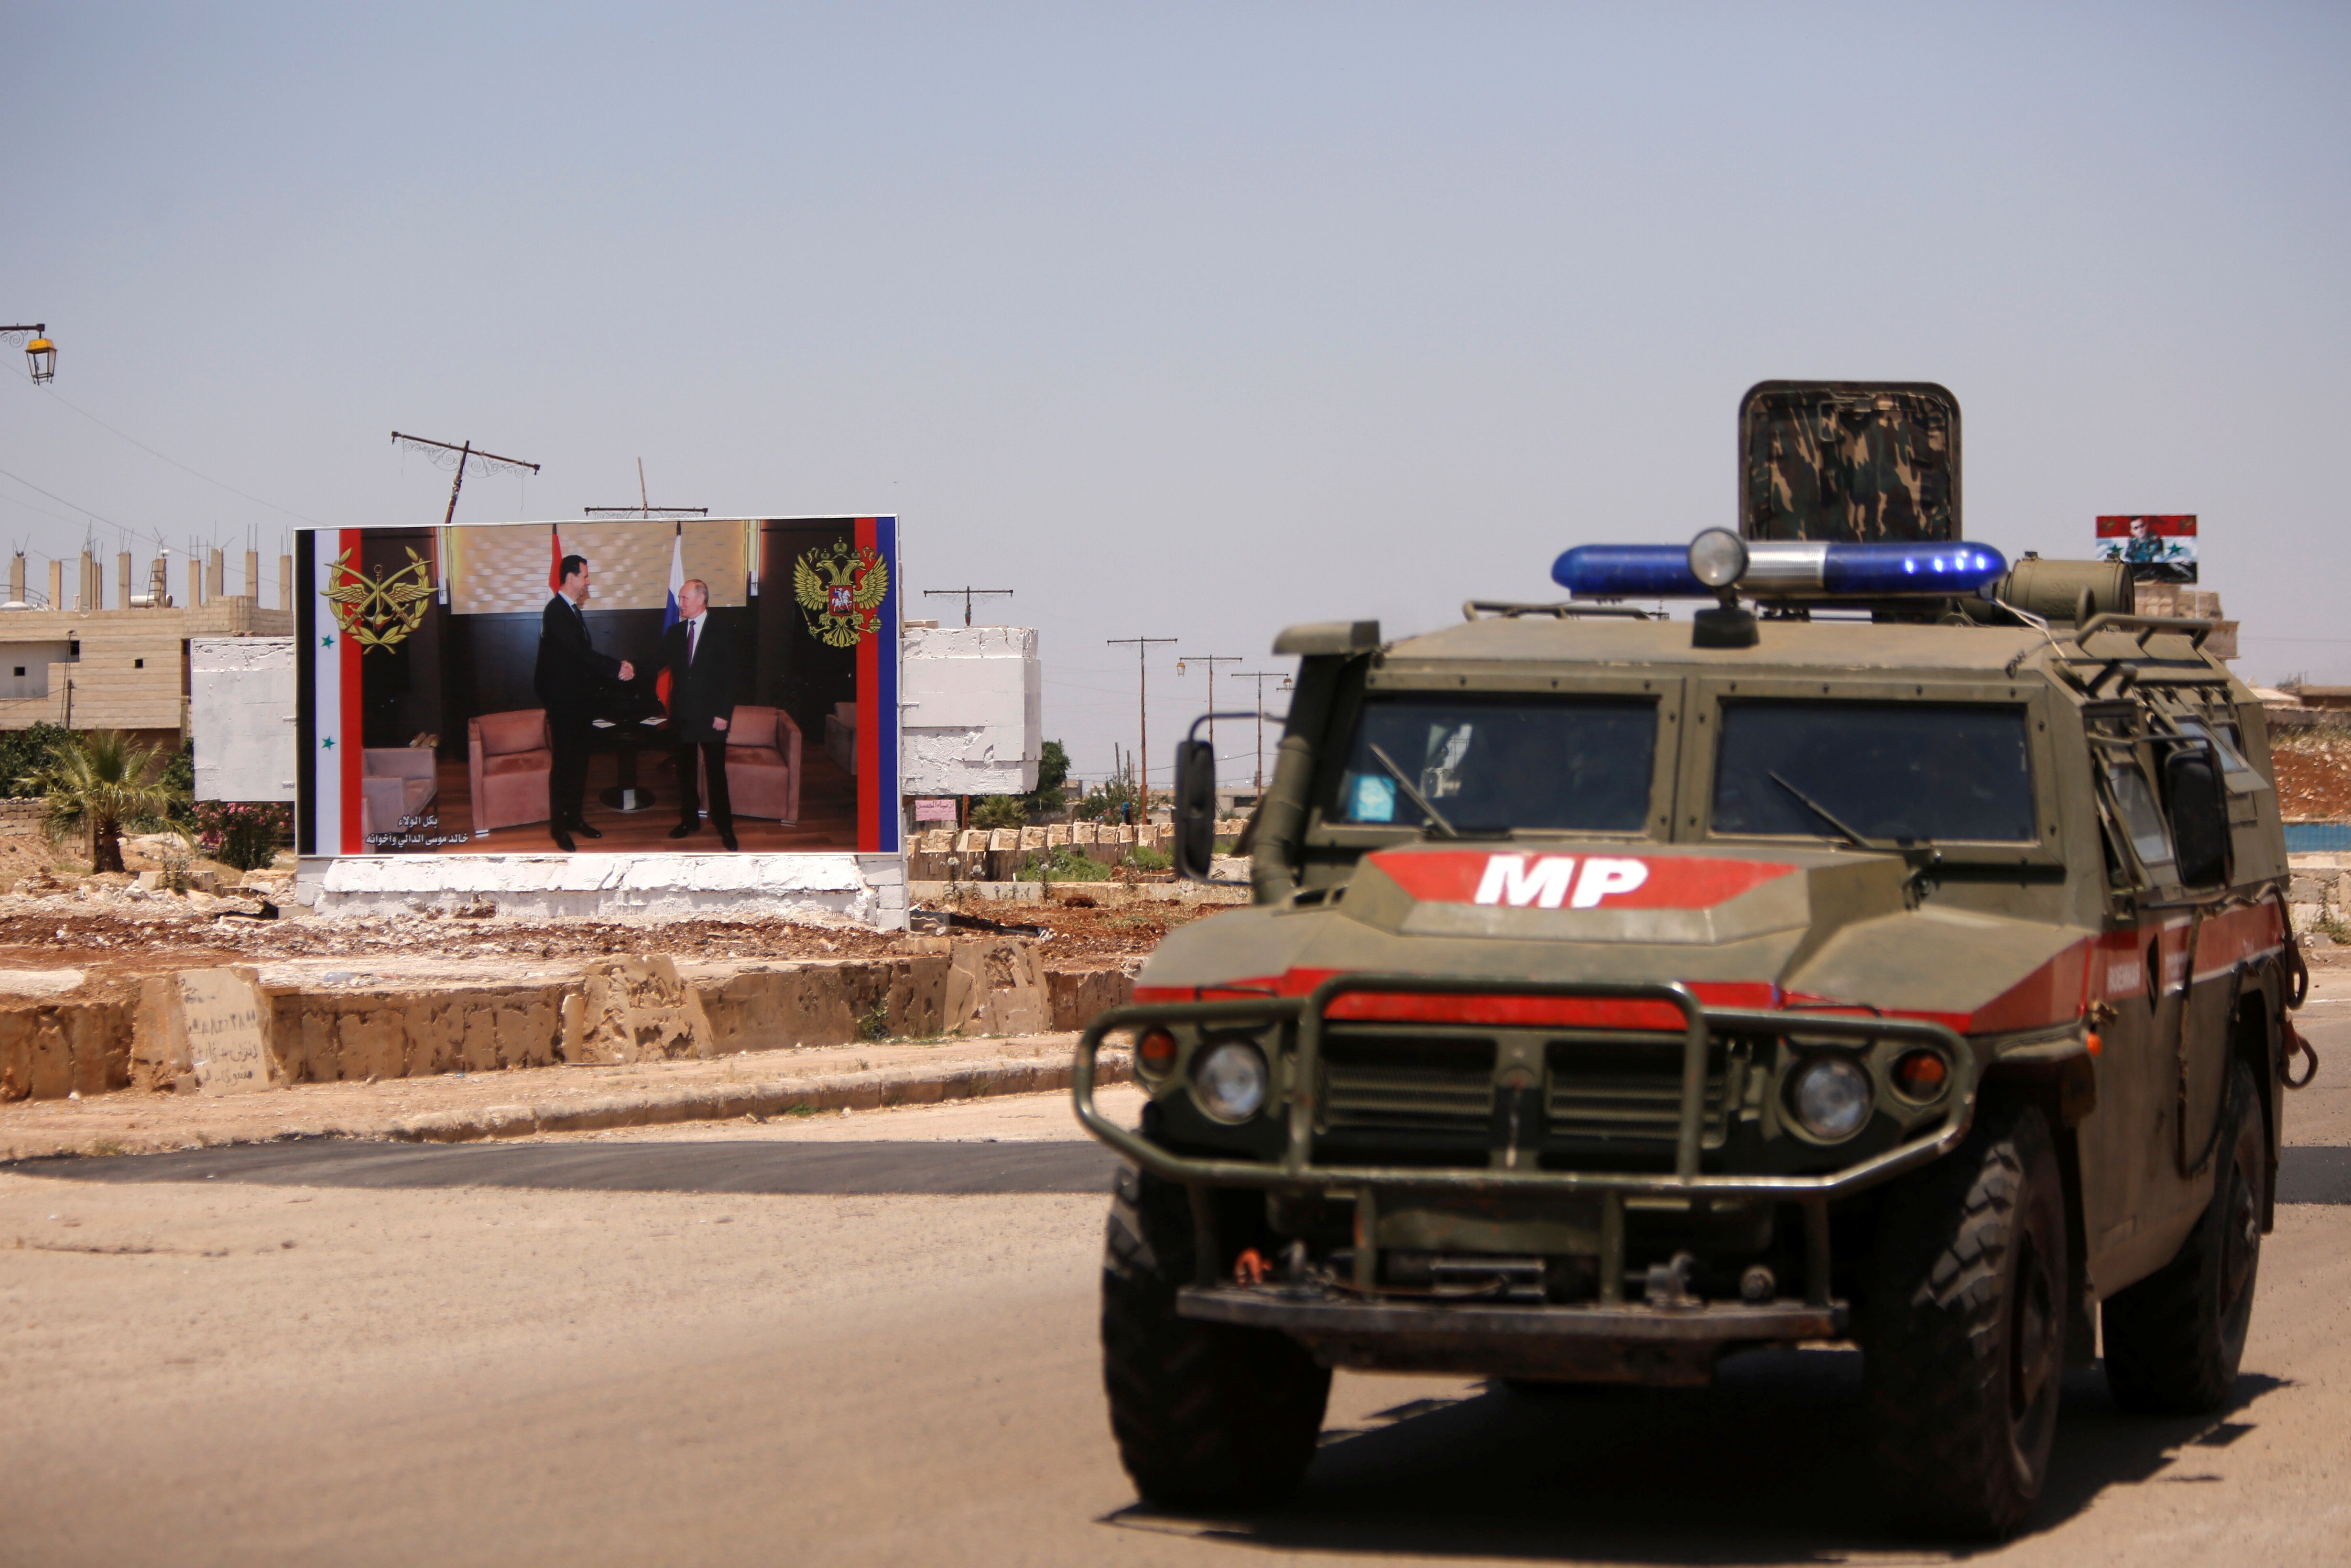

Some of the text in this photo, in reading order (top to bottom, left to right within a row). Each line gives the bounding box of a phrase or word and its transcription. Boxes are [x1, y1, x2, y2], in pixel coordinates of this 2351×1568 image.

[398, 815, 437, 828] بكل الولاء
[398, 834, 424, 848] الدالي
[425, 837, 446, 846] موسى
[448, 832, 468, 843] خالد
[1475, 853, 1649, 909] MP
